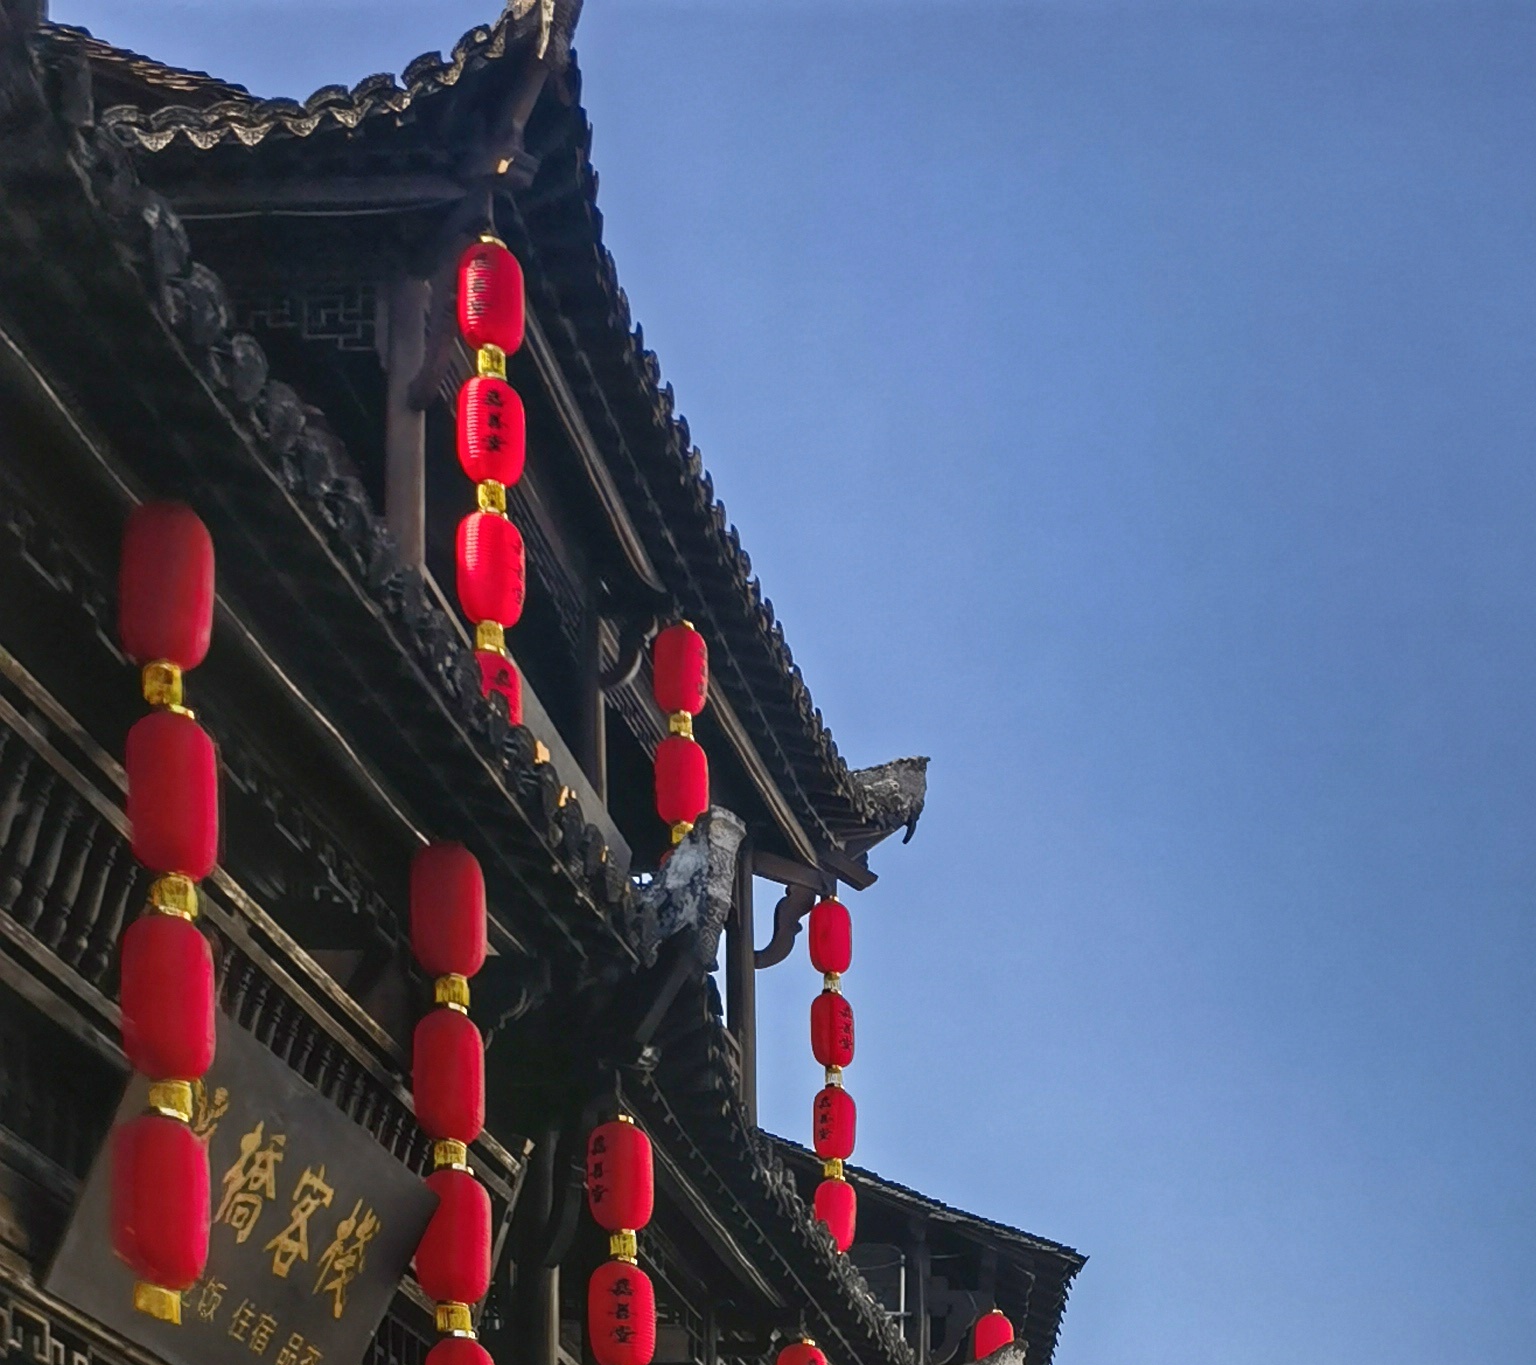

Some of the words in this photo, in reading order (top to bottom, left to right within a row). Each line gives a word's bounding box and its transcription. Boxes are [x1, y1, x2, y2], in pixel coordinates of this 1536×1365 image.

[193, 1079, 381, 1319] 橋客棧
[228, 1298, 278, 1355] 住宿
